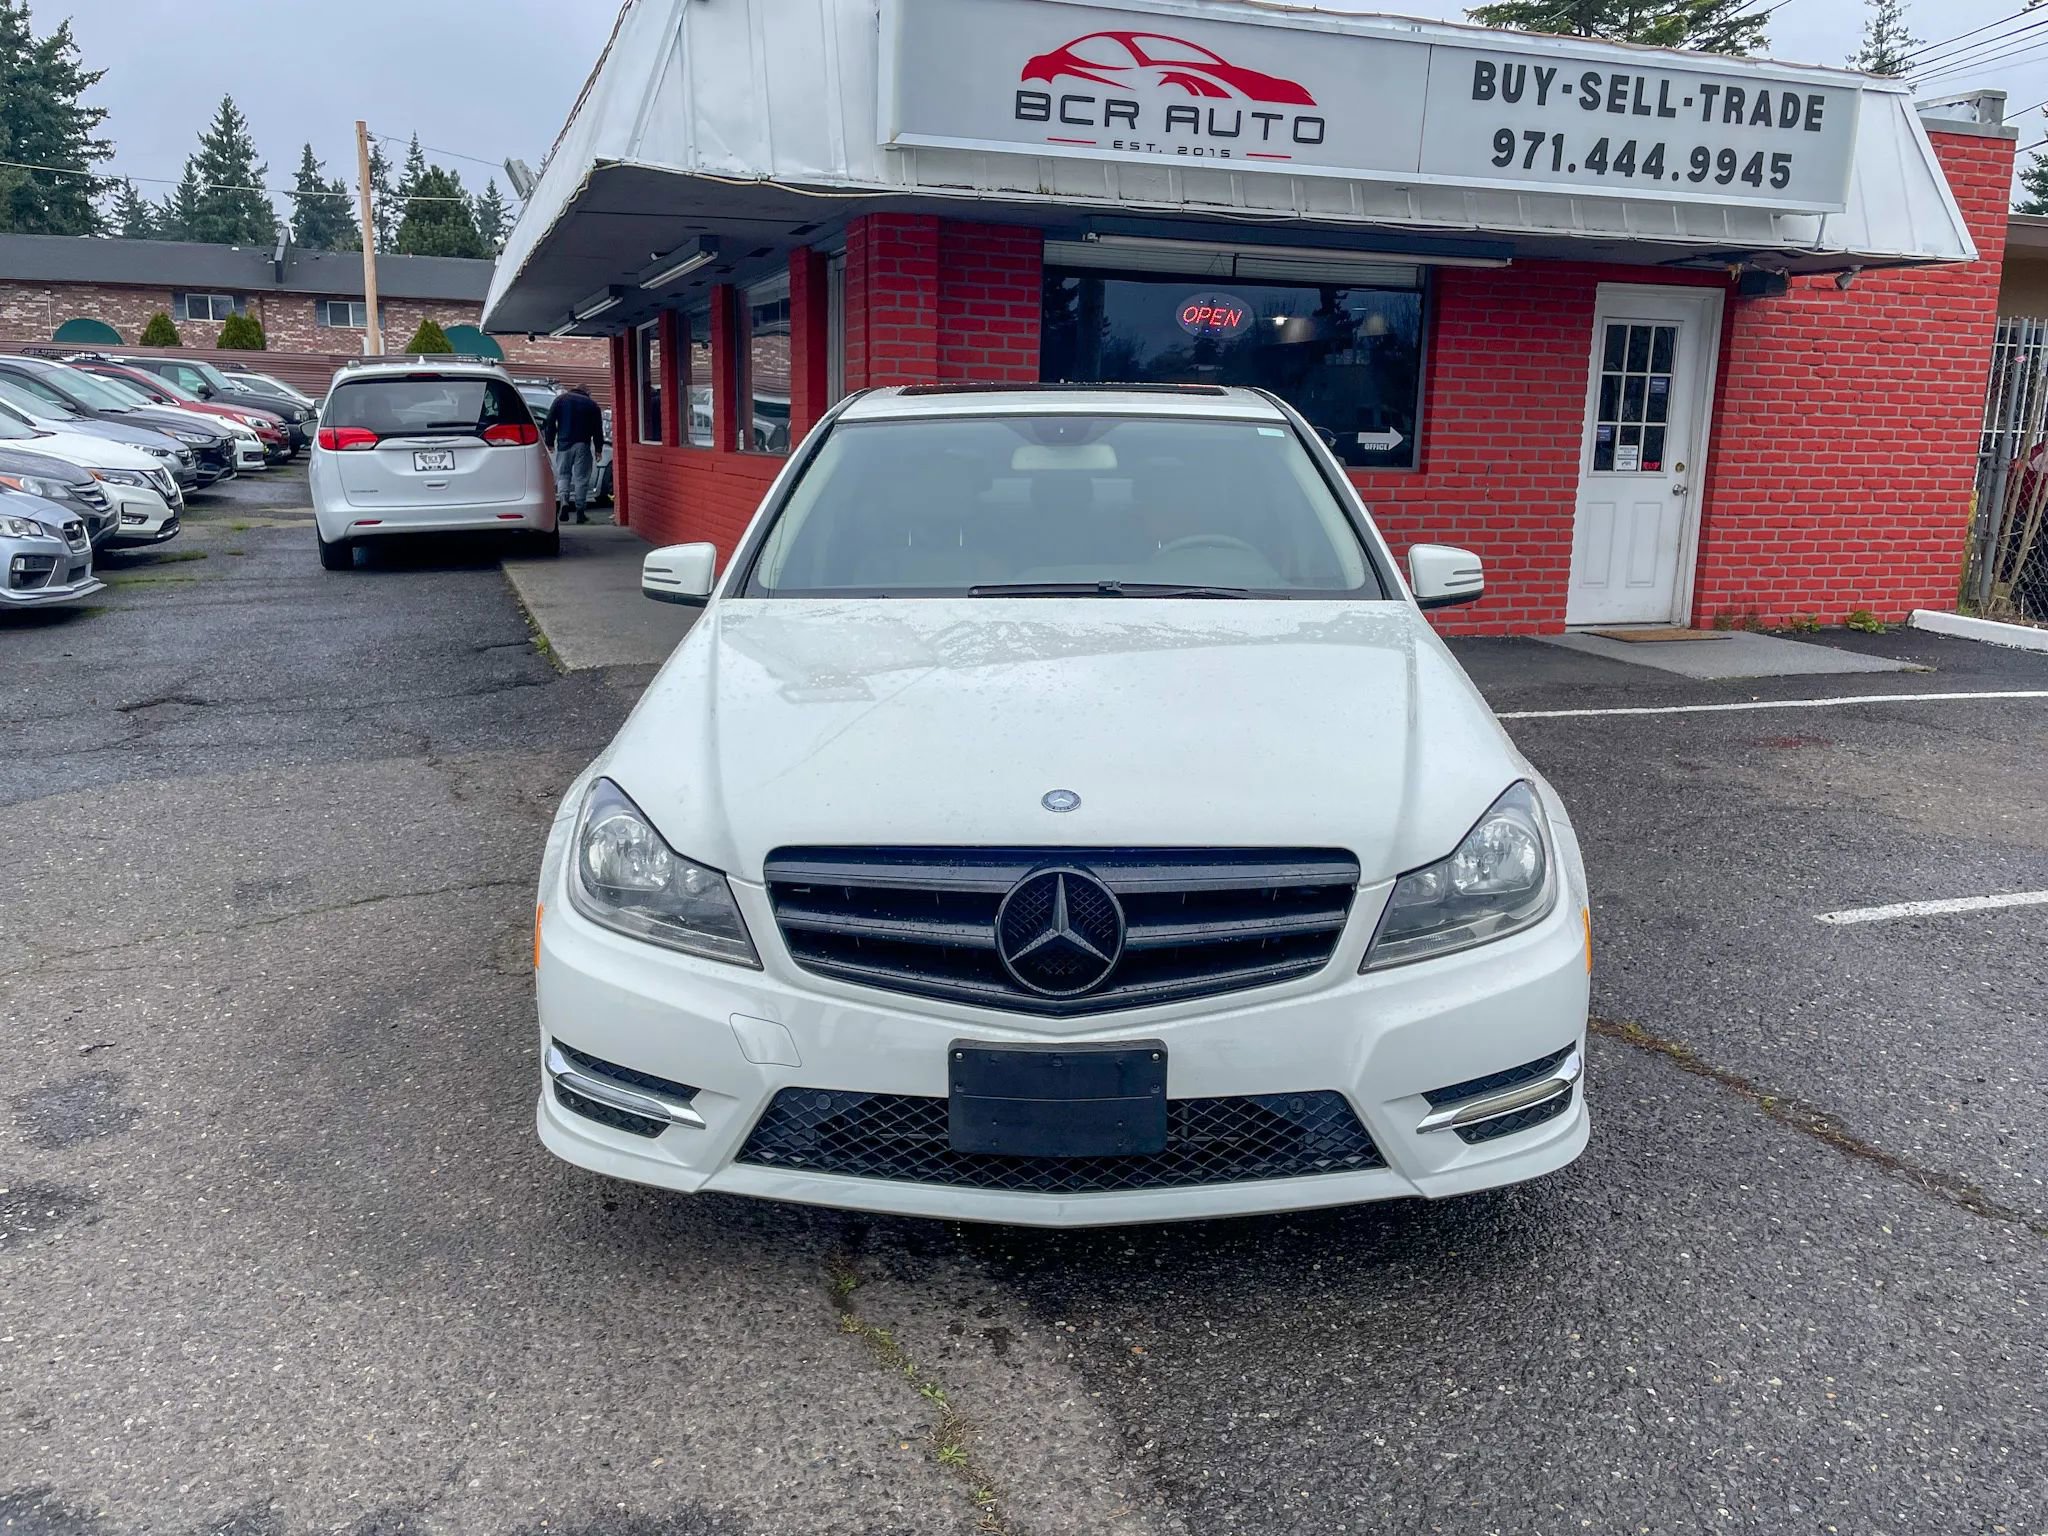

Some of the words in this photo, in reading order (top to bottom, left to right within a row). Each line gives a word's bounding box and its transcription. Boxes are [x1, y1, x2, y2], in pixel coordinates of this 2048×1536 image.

[1015, 90, 1140, 130] BCR
[1165, 105, 1325, 145] AUTO
[1113, 140, 1162, 153] EST.
[1177, 146, 1231, 158] 2015
[1491, 127, 1793, 189] 971.444.9945
[1183, 305, 1243, 327] OPEN
